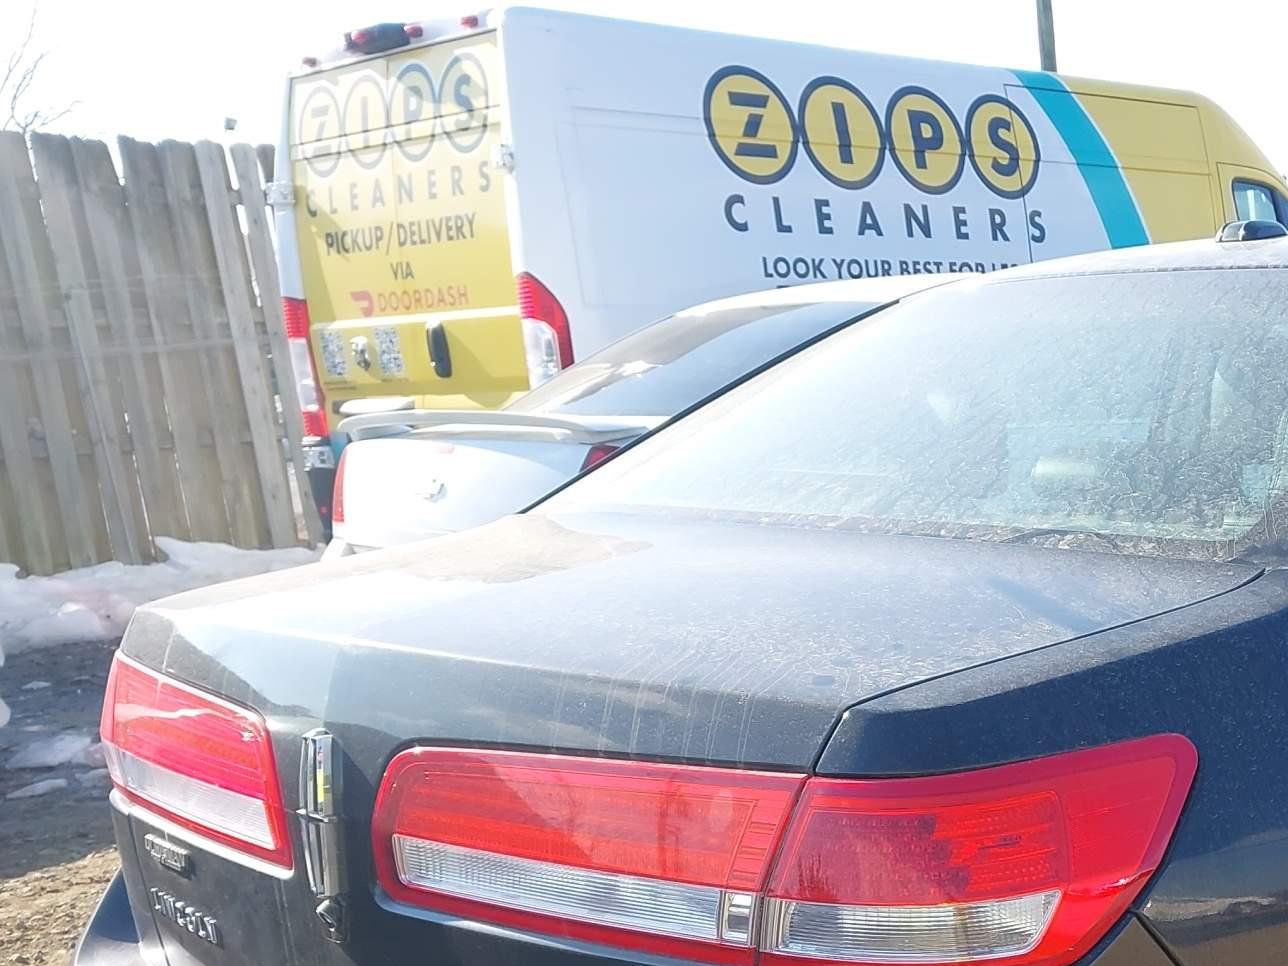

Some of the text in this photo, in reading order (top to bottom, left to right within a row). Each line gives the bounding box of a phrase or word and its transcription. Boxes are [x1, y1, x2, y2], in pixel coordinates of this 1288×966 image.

[307, 70, 481, 151] ZIPS
[723, 87, 1024, 179] ZIPS
[306, 161, 491, 218] CLEANERS
[325, 213, 476, 256] PICKUP/DELIVERY
[724, 194, 1046, 244] CLEANERS
[389, 261, 415, 281] VIA
[762, 255, 828, 280] LOOK
[831, 257, 893, 280] YOUR
[898, 260, 943, 275] BEST
[378, 286, 468, 313] DOORDASH
